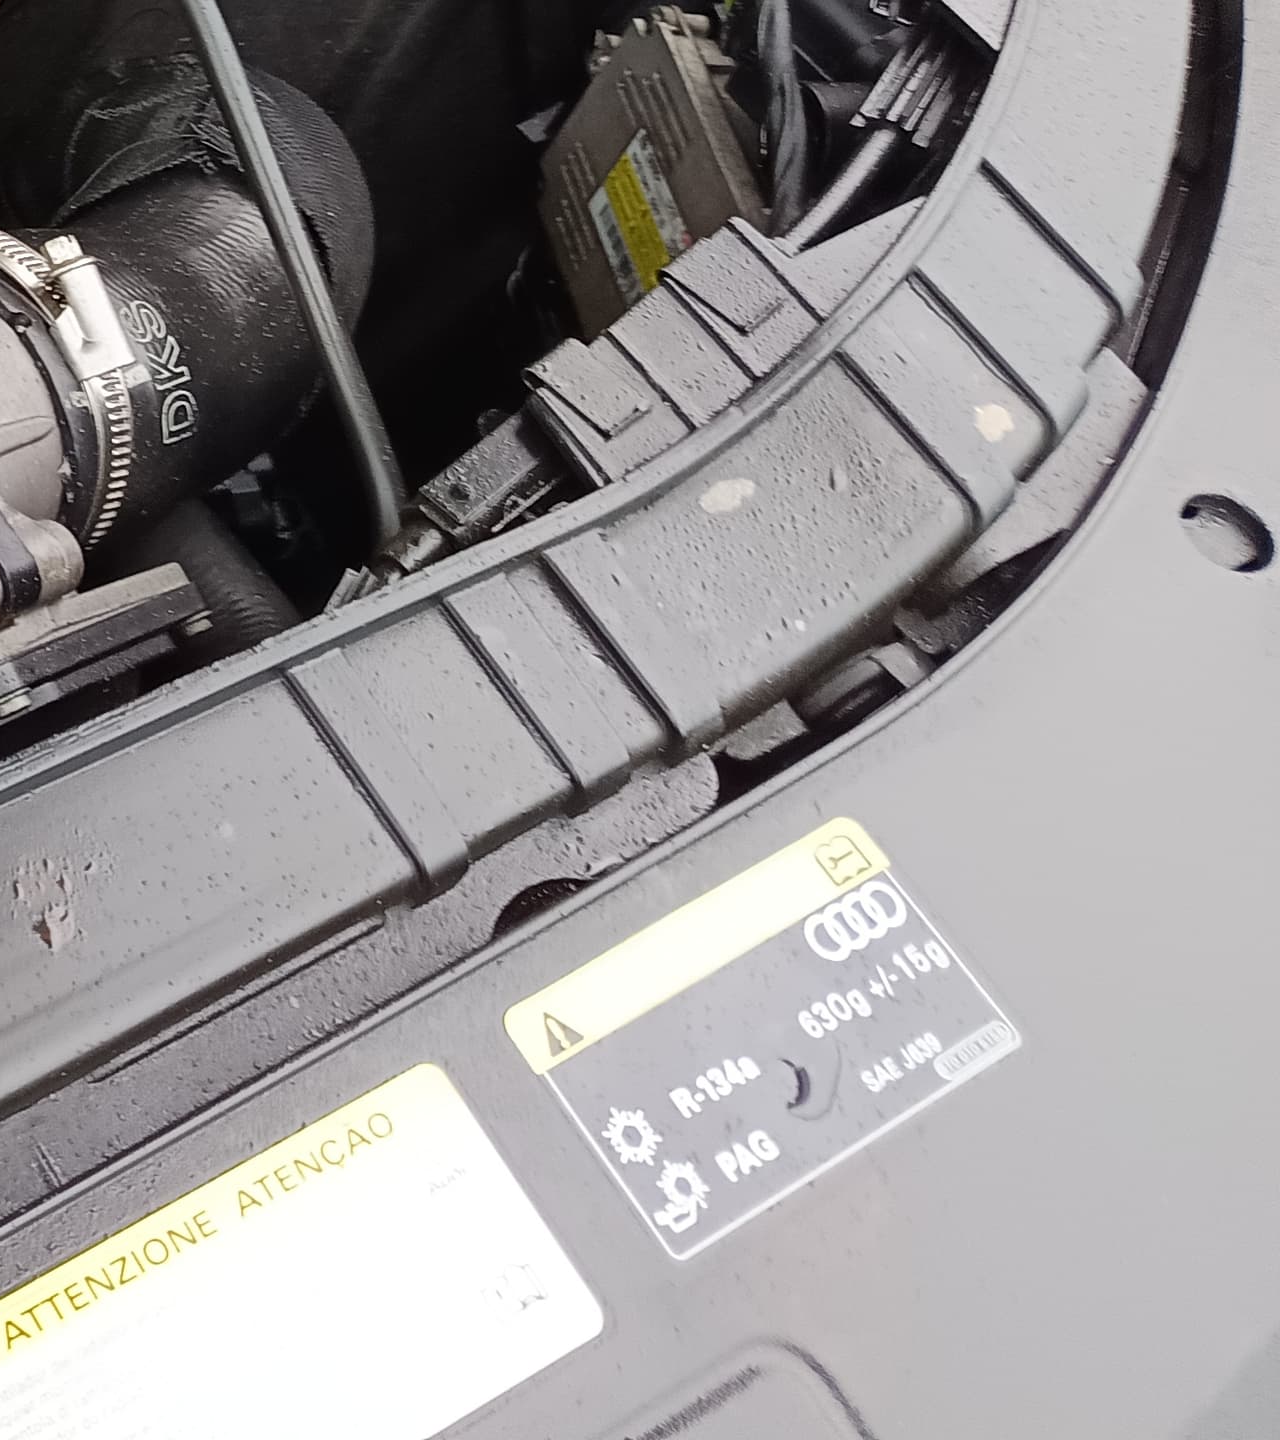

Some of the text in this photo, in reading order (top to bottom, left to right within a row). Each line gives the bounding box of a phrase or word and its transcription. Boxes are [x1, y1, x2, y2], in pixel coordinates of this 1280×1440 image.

[121, 299, 199, 445] DKS
[796, 987, 873, 1039] 630g
[669, 1055, 762, 1119] R-134a
[860, 1056, 905, 1093] SAE
[714, 1129, 781, 1183] PAG
[4, 1209, 219, 1350] ATTENZIONE
